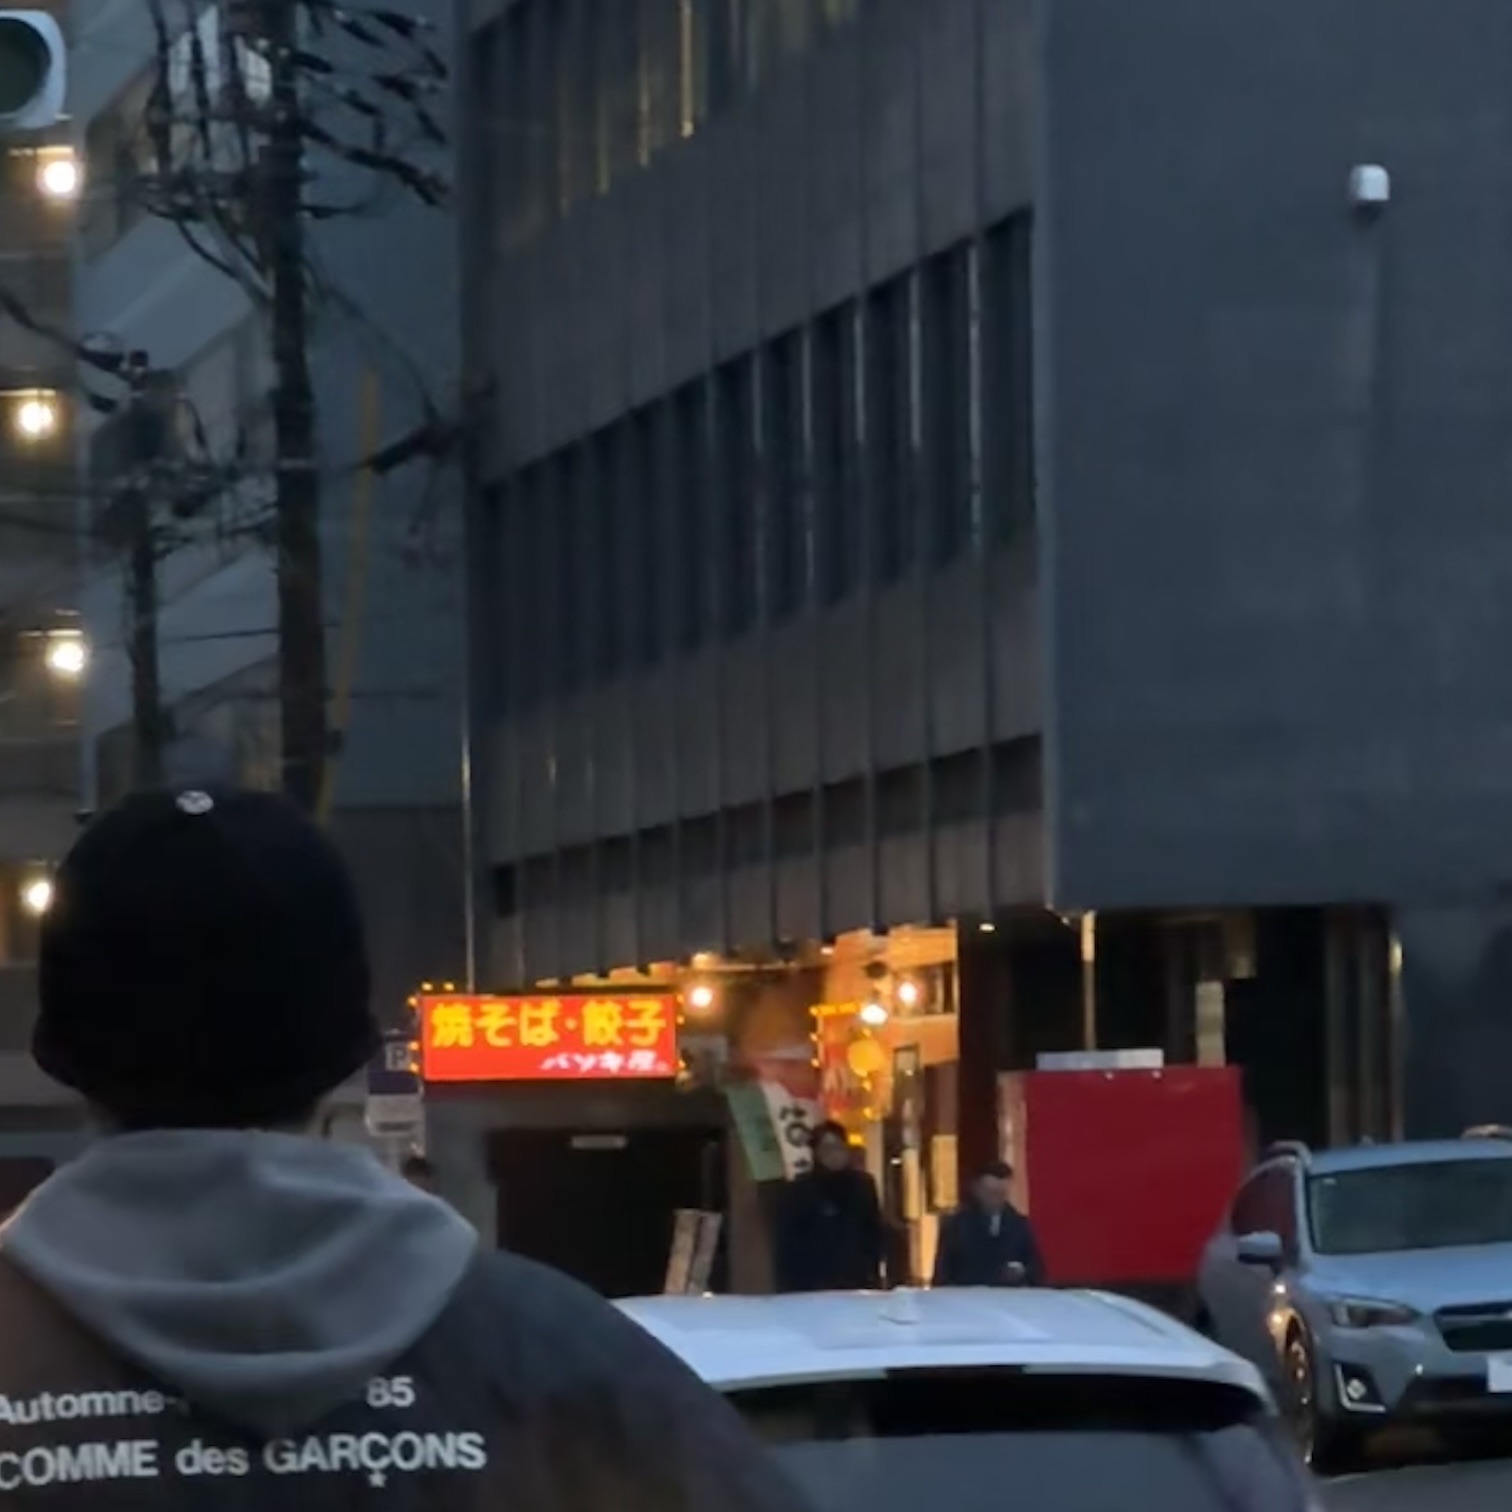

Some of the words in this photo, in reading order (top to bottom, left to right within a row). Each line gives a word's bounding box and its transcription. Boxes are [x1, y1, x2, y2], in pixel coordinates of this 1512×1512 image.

[431, 1000, 666, 1047] 焼そば・餃子
[175, 1438, 249, 1476] des
[263, 1431, 487, 1488] GARÇONS
